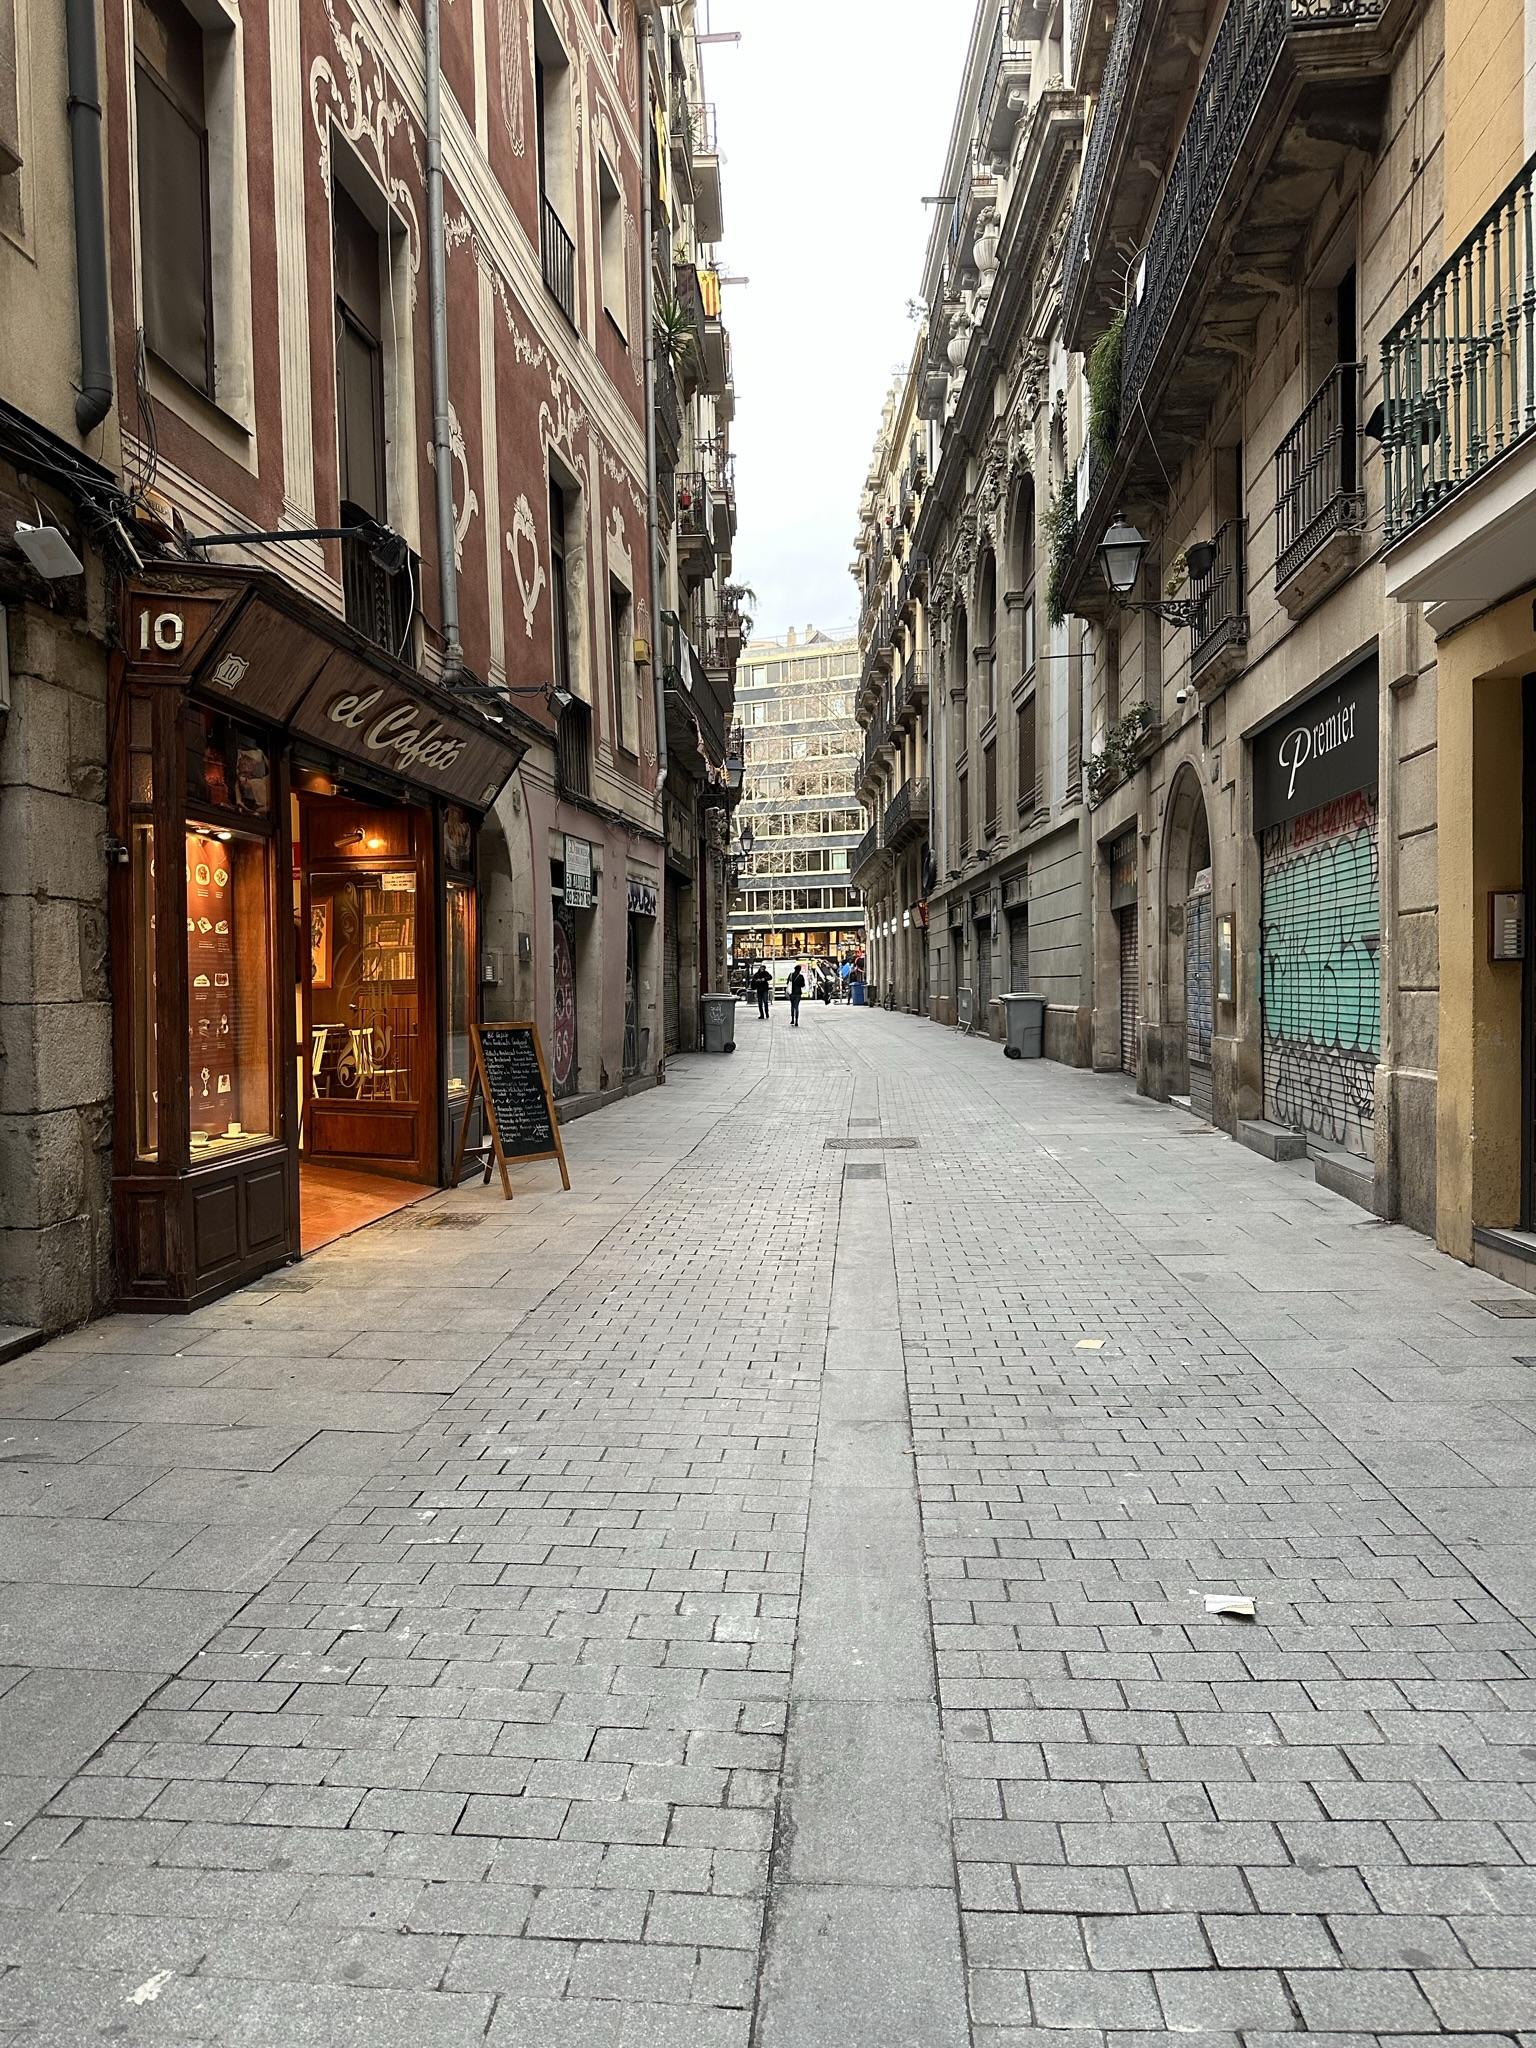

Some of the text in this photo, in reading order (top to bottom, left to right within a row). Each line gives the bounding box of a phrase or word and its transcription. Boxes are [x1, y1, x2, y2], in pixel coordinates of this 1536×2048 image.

[139, 610, 183, 650] 10
[222, 663, 239, 681] 10
[332, 689, 384, 728] el
[1279, 696, 1356, 800] Premier
